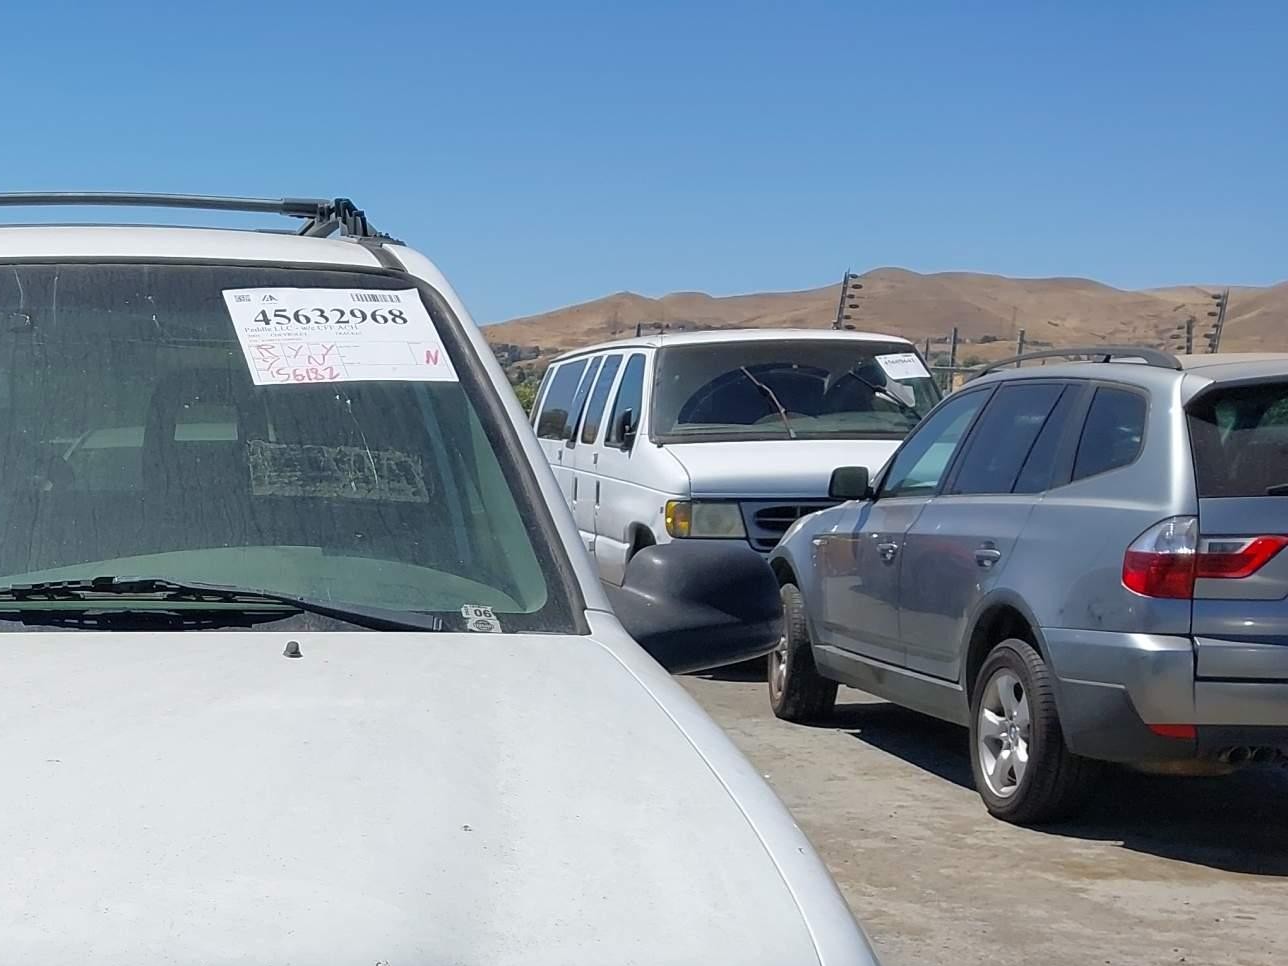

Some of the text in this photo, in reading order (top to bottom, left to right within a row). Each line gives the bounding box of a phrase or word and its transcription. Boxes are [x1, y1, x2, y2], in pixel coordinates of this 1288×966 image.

[253, 308, 409, 326] 45632968
[425, 350, 440, 365] N
[473, 608, 492, 618] 06
